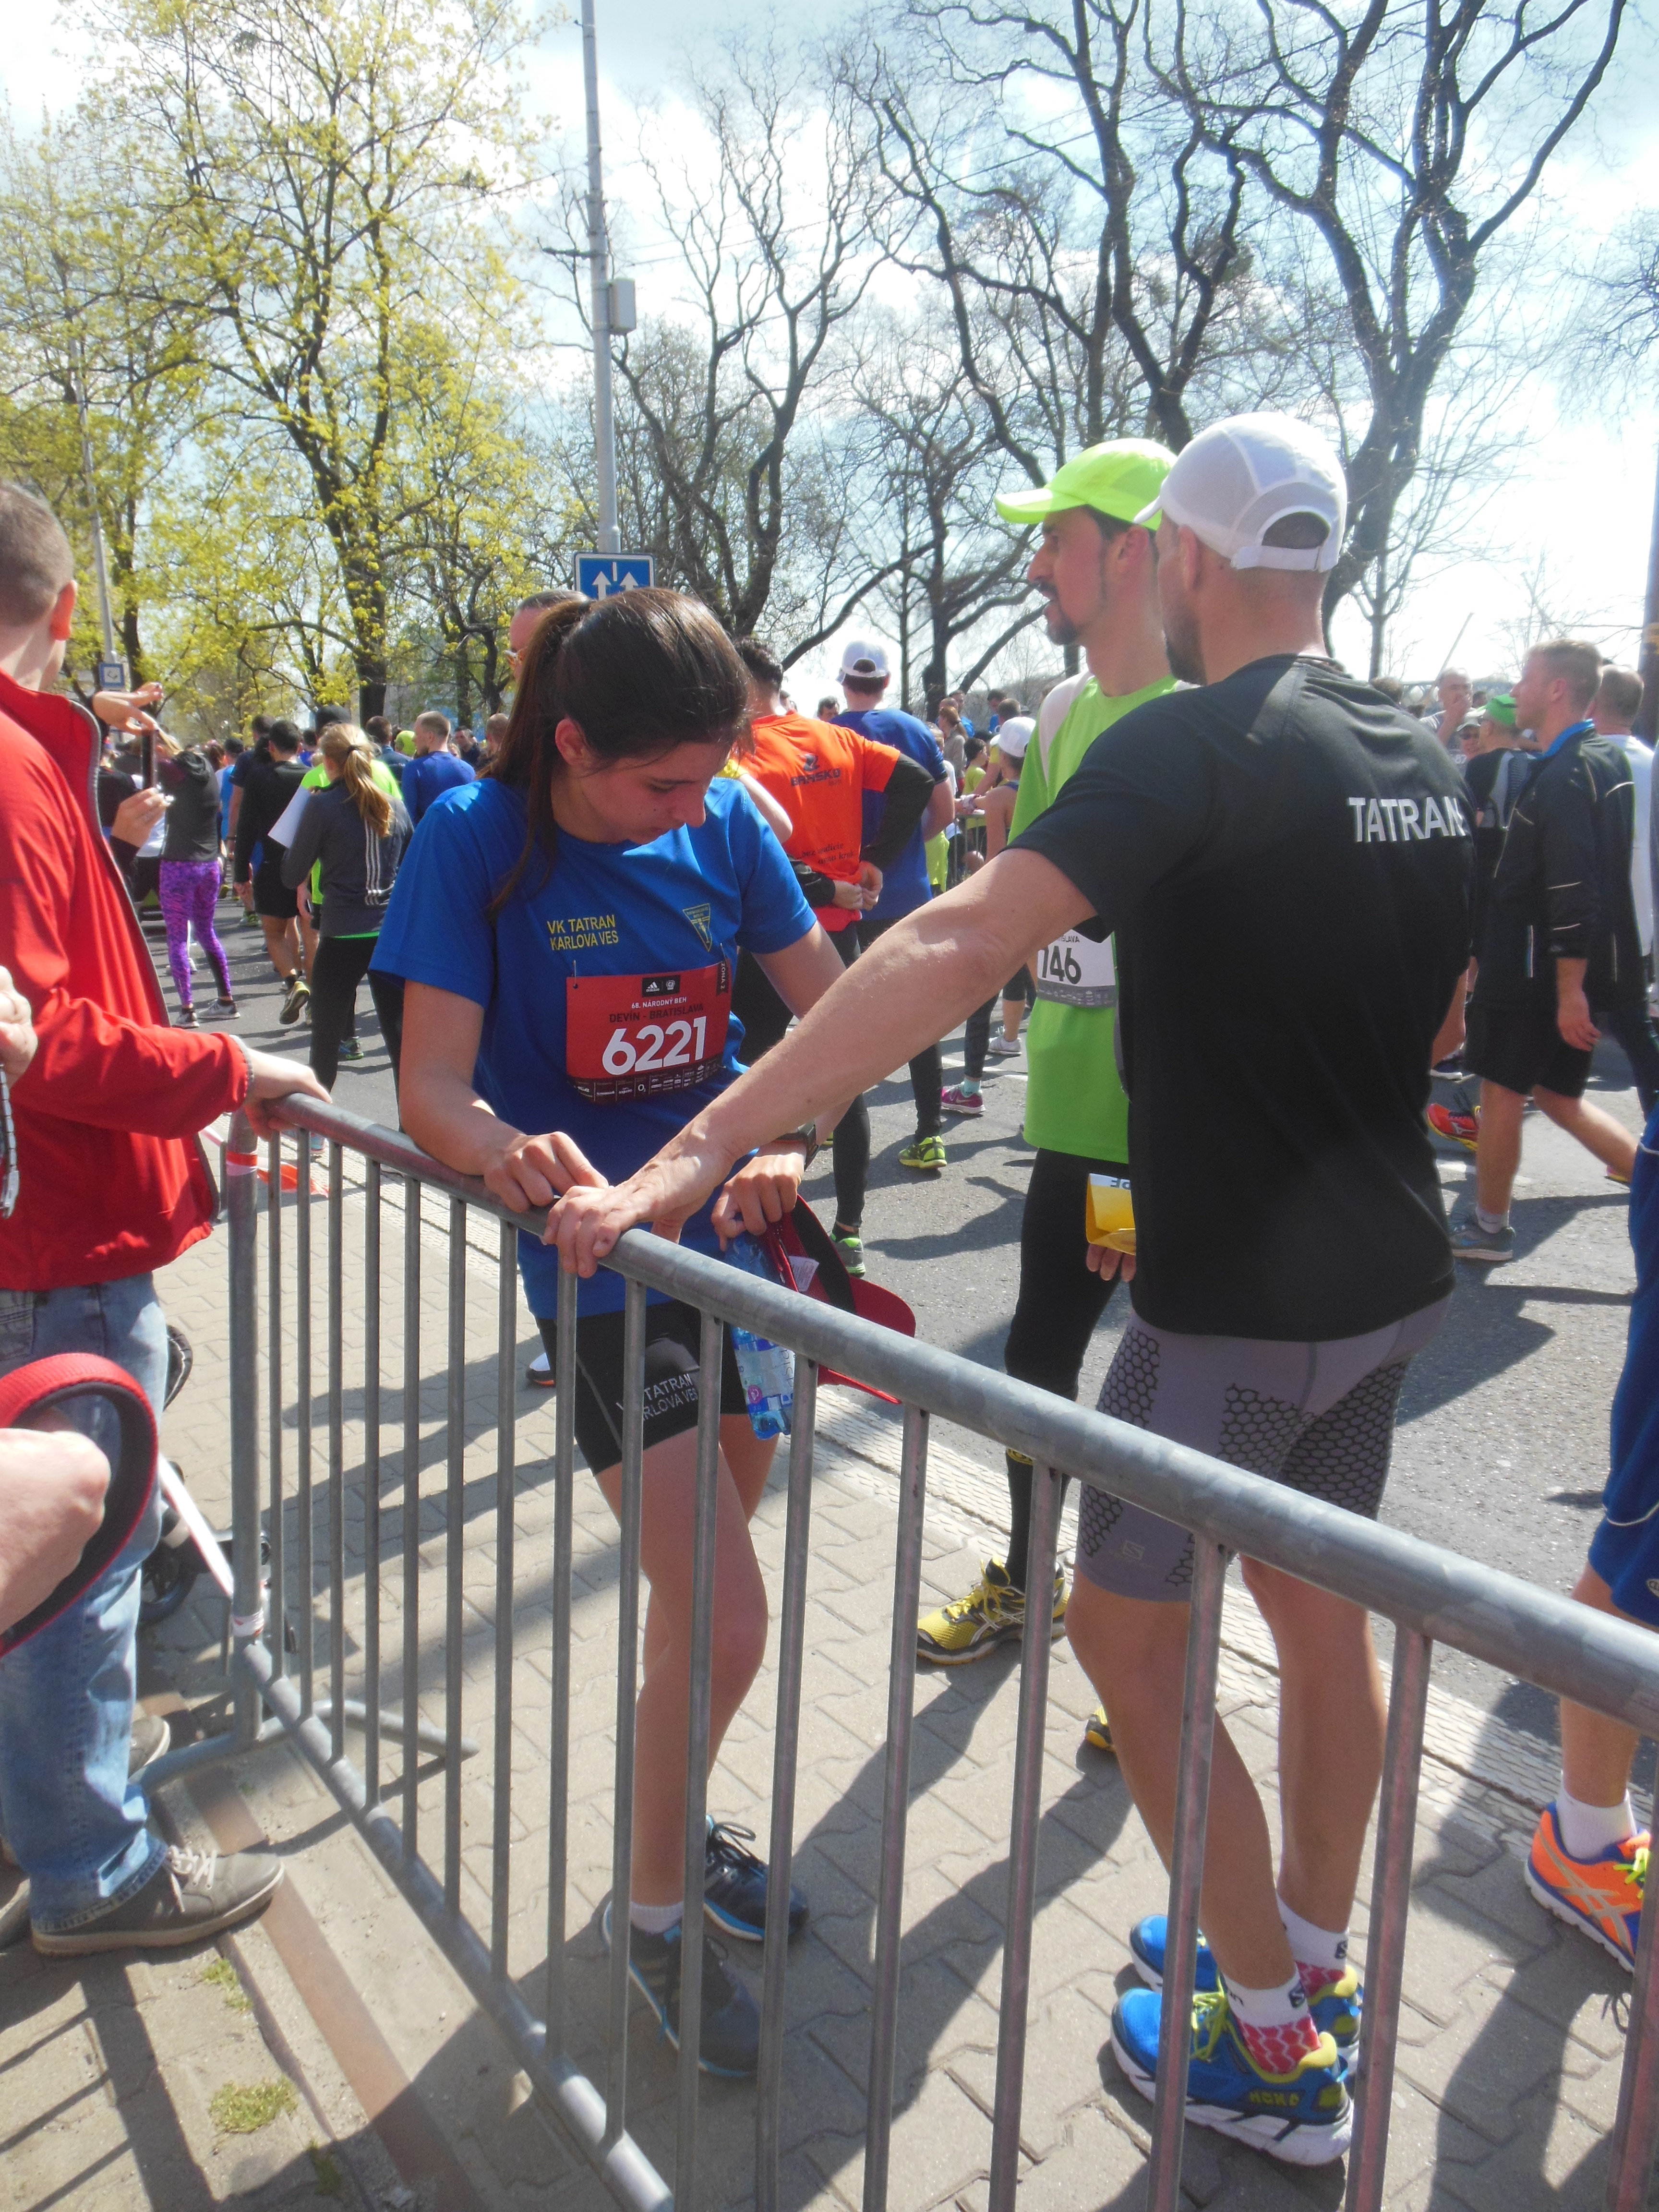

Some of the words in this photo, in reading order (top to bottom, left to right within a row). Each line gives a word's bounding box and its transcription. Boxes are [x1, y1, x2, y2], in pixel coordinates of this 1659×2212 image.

[1349, 796, 1466, 842] TATRAN
[547, 920, 565, 934] VK
[568, 914, 615, 932] TATRAN
[550, 933, 598, 950] KARLOVA
[598, 930, 619, 945] VES
[642, 997, 673, 1008] NÁRODNÝ
[609, 1012, 640, 1022] DEVÍN
[649, 1004, 703, 1019] BRATISLAVA
[602, 1016, 707, 1075] 6221
[644, 1373, 693, 1401] TATRAN
